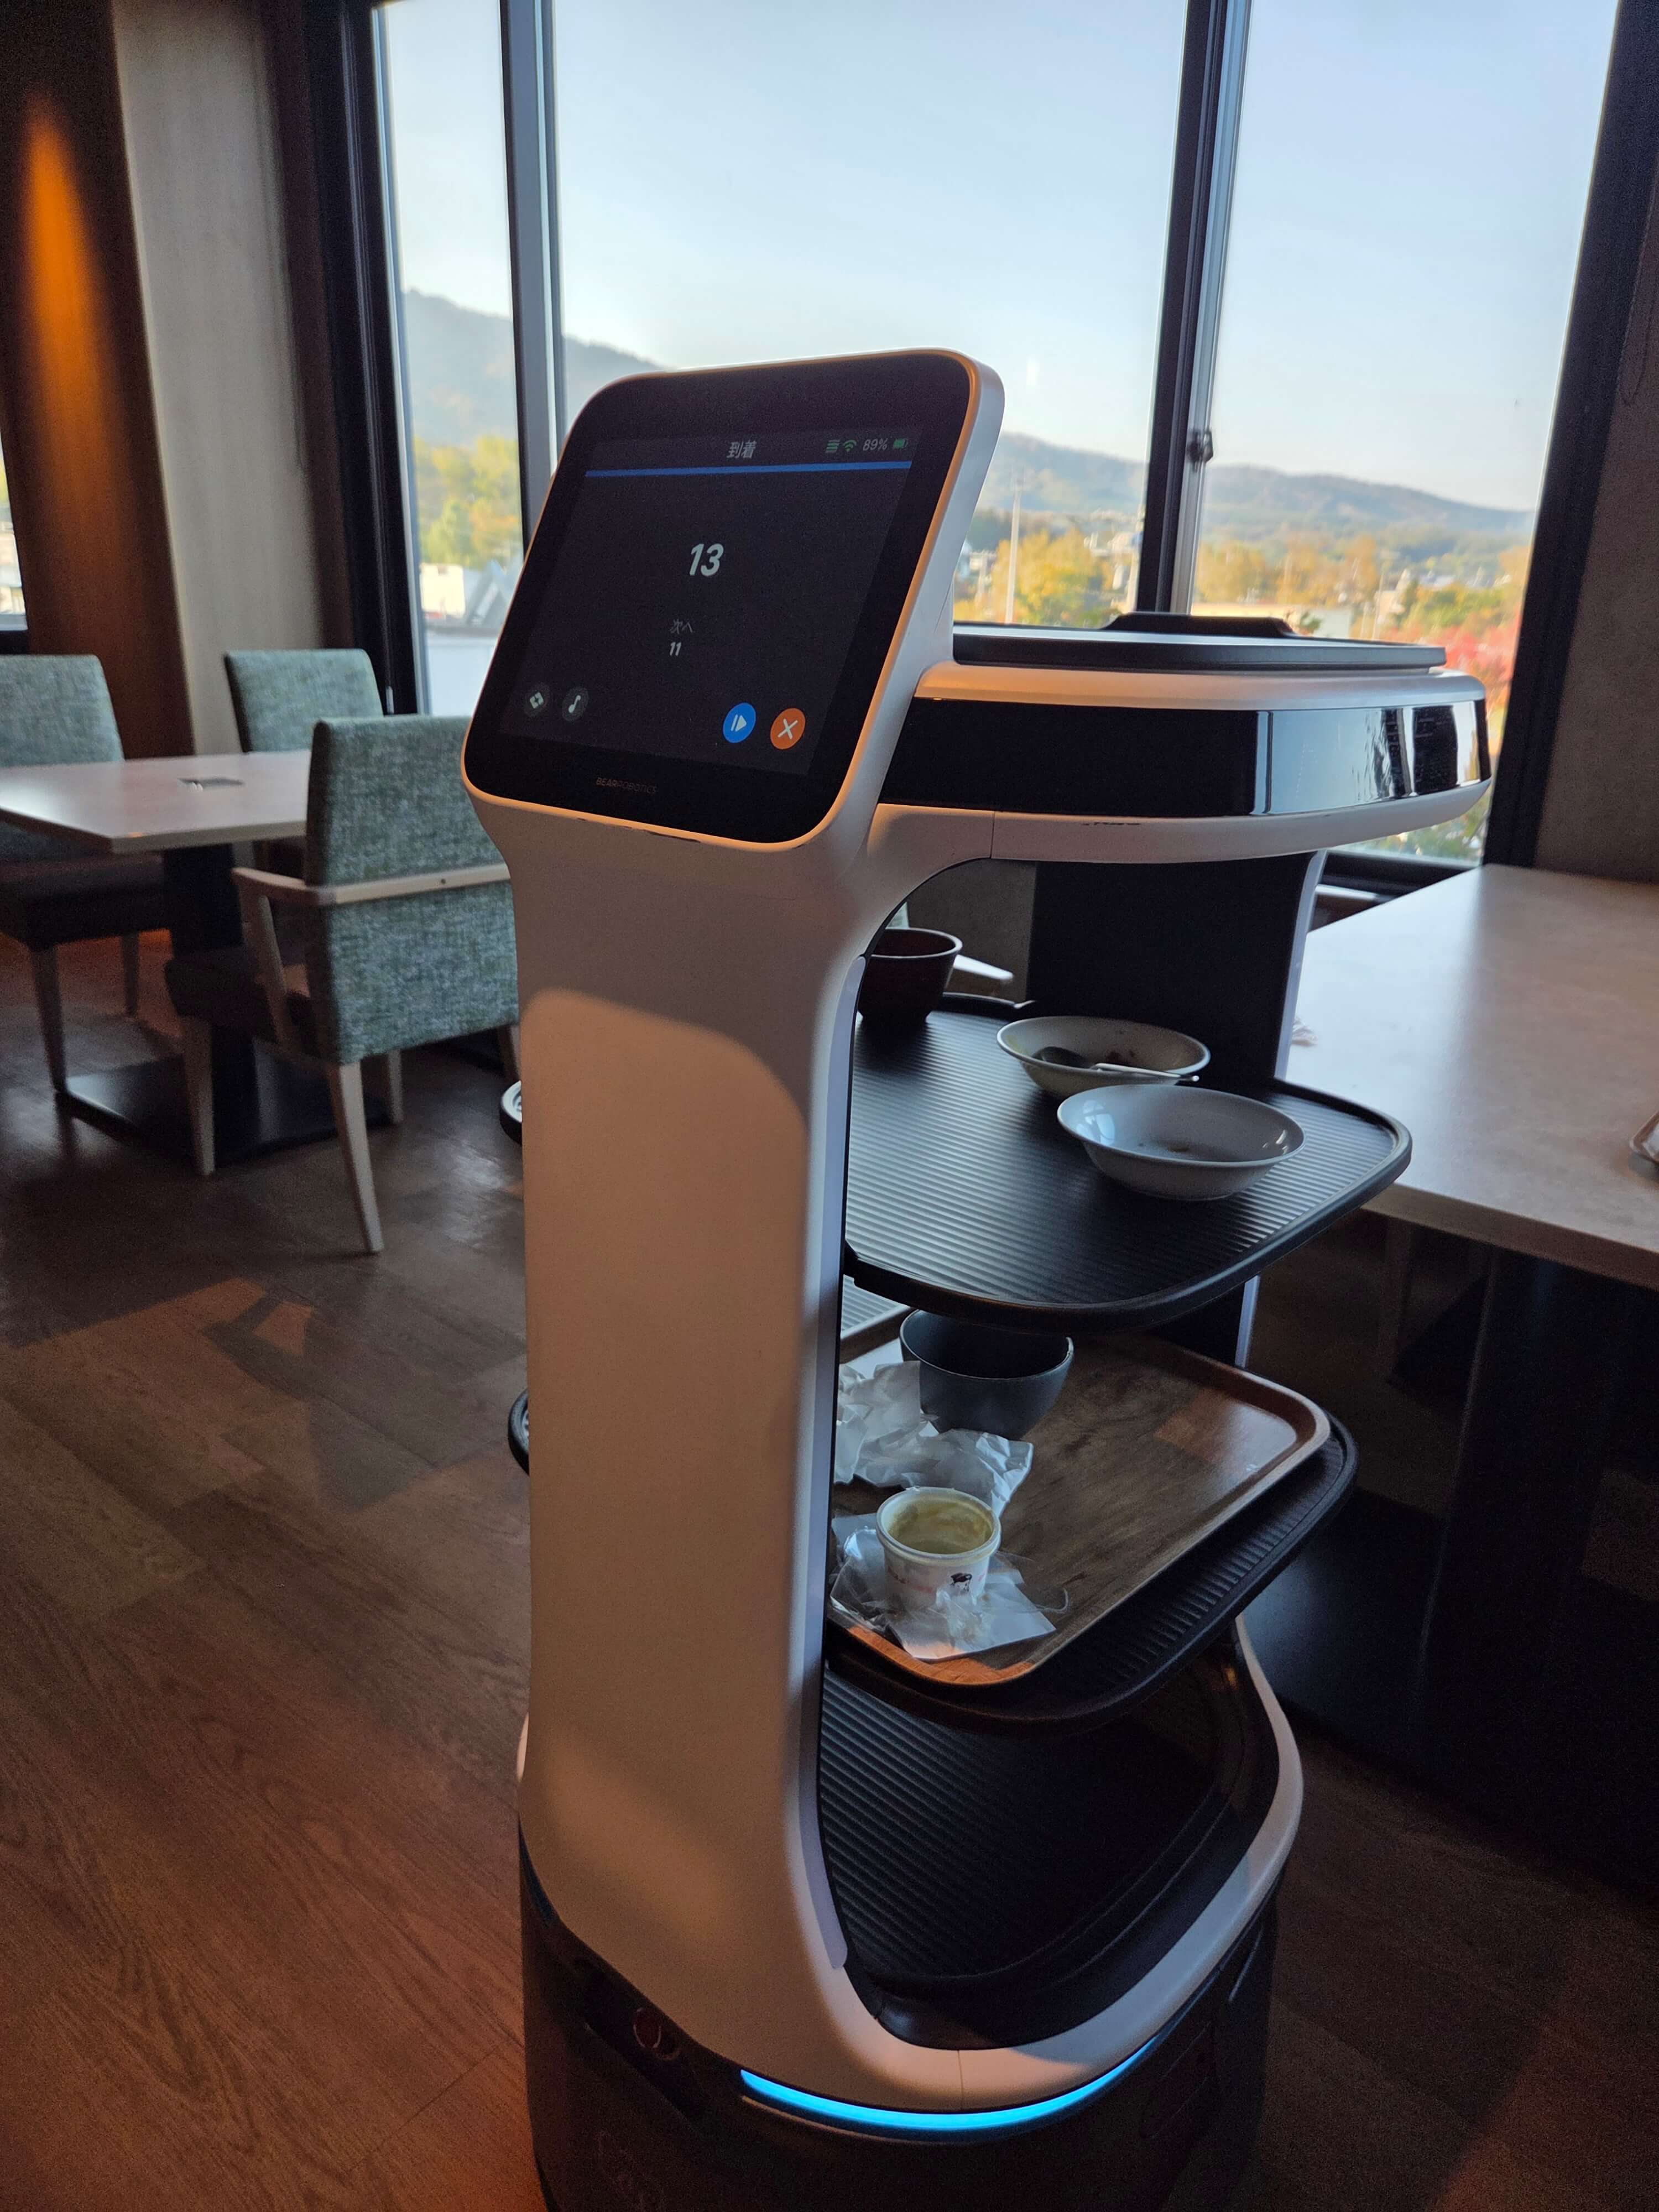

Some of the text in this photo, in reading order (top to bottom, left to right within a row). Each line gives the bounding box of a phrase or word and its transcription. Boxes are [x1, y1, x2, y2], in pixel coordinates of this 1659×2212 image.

[726, 439, 757, 458] 到着
[863, 438, 889, 452] 89%
[690, 544, 724, 577] 13
[670, 619, 693, 634] 次へ
[670, 641, 682, 657] 11
